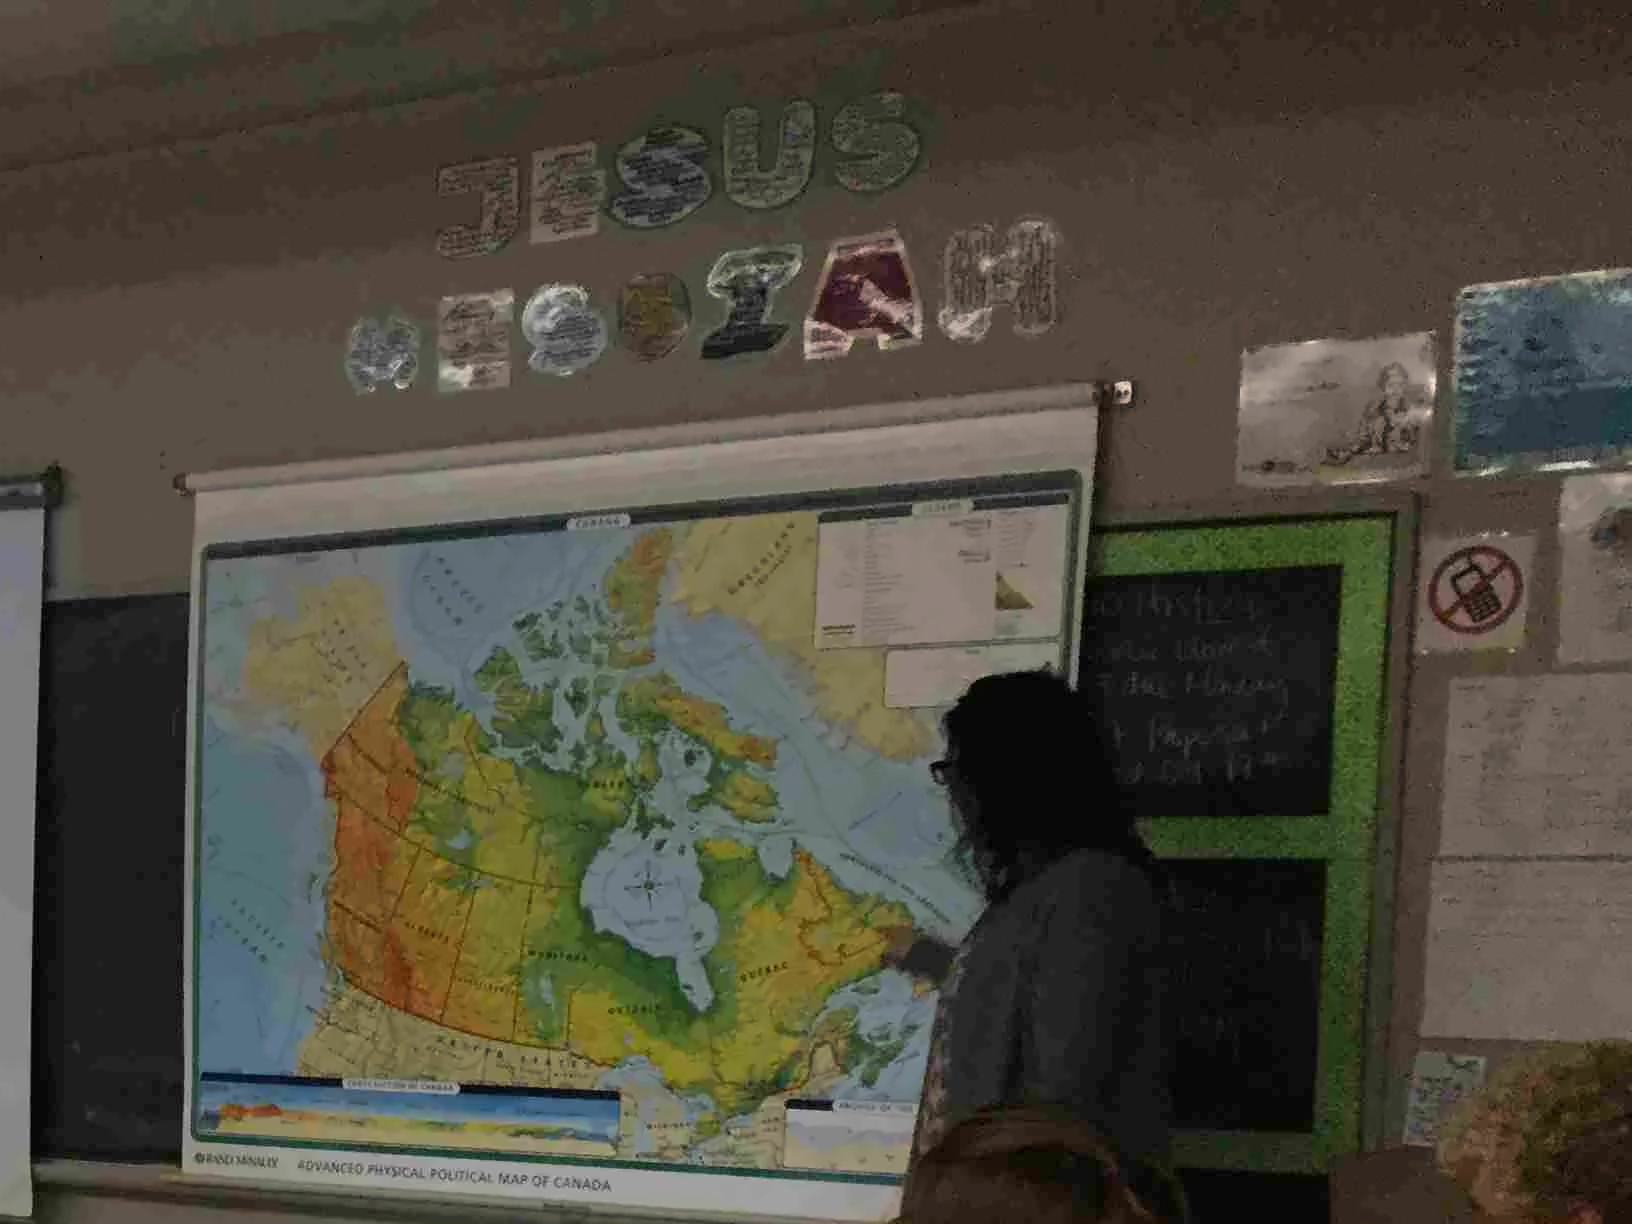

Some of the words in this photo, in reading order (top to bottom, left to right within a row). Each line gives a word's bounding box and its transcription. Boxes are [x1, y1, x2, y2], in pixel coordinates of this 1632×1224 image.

[434, 90, 921, 260] JESUS
[346, 218, 1058, 396] MESSIAH
[297, 1158, 364, 1175] ADVANCED
[367, 1163, 426, 1180] PHYSICAL
[429, 1167, 494, 1184] POLITICAL
[497, 1171, 529, 1186] MAP
[531, 1174, 551, 1189] OF
[553, 1176, 613, 1192] CANADA
